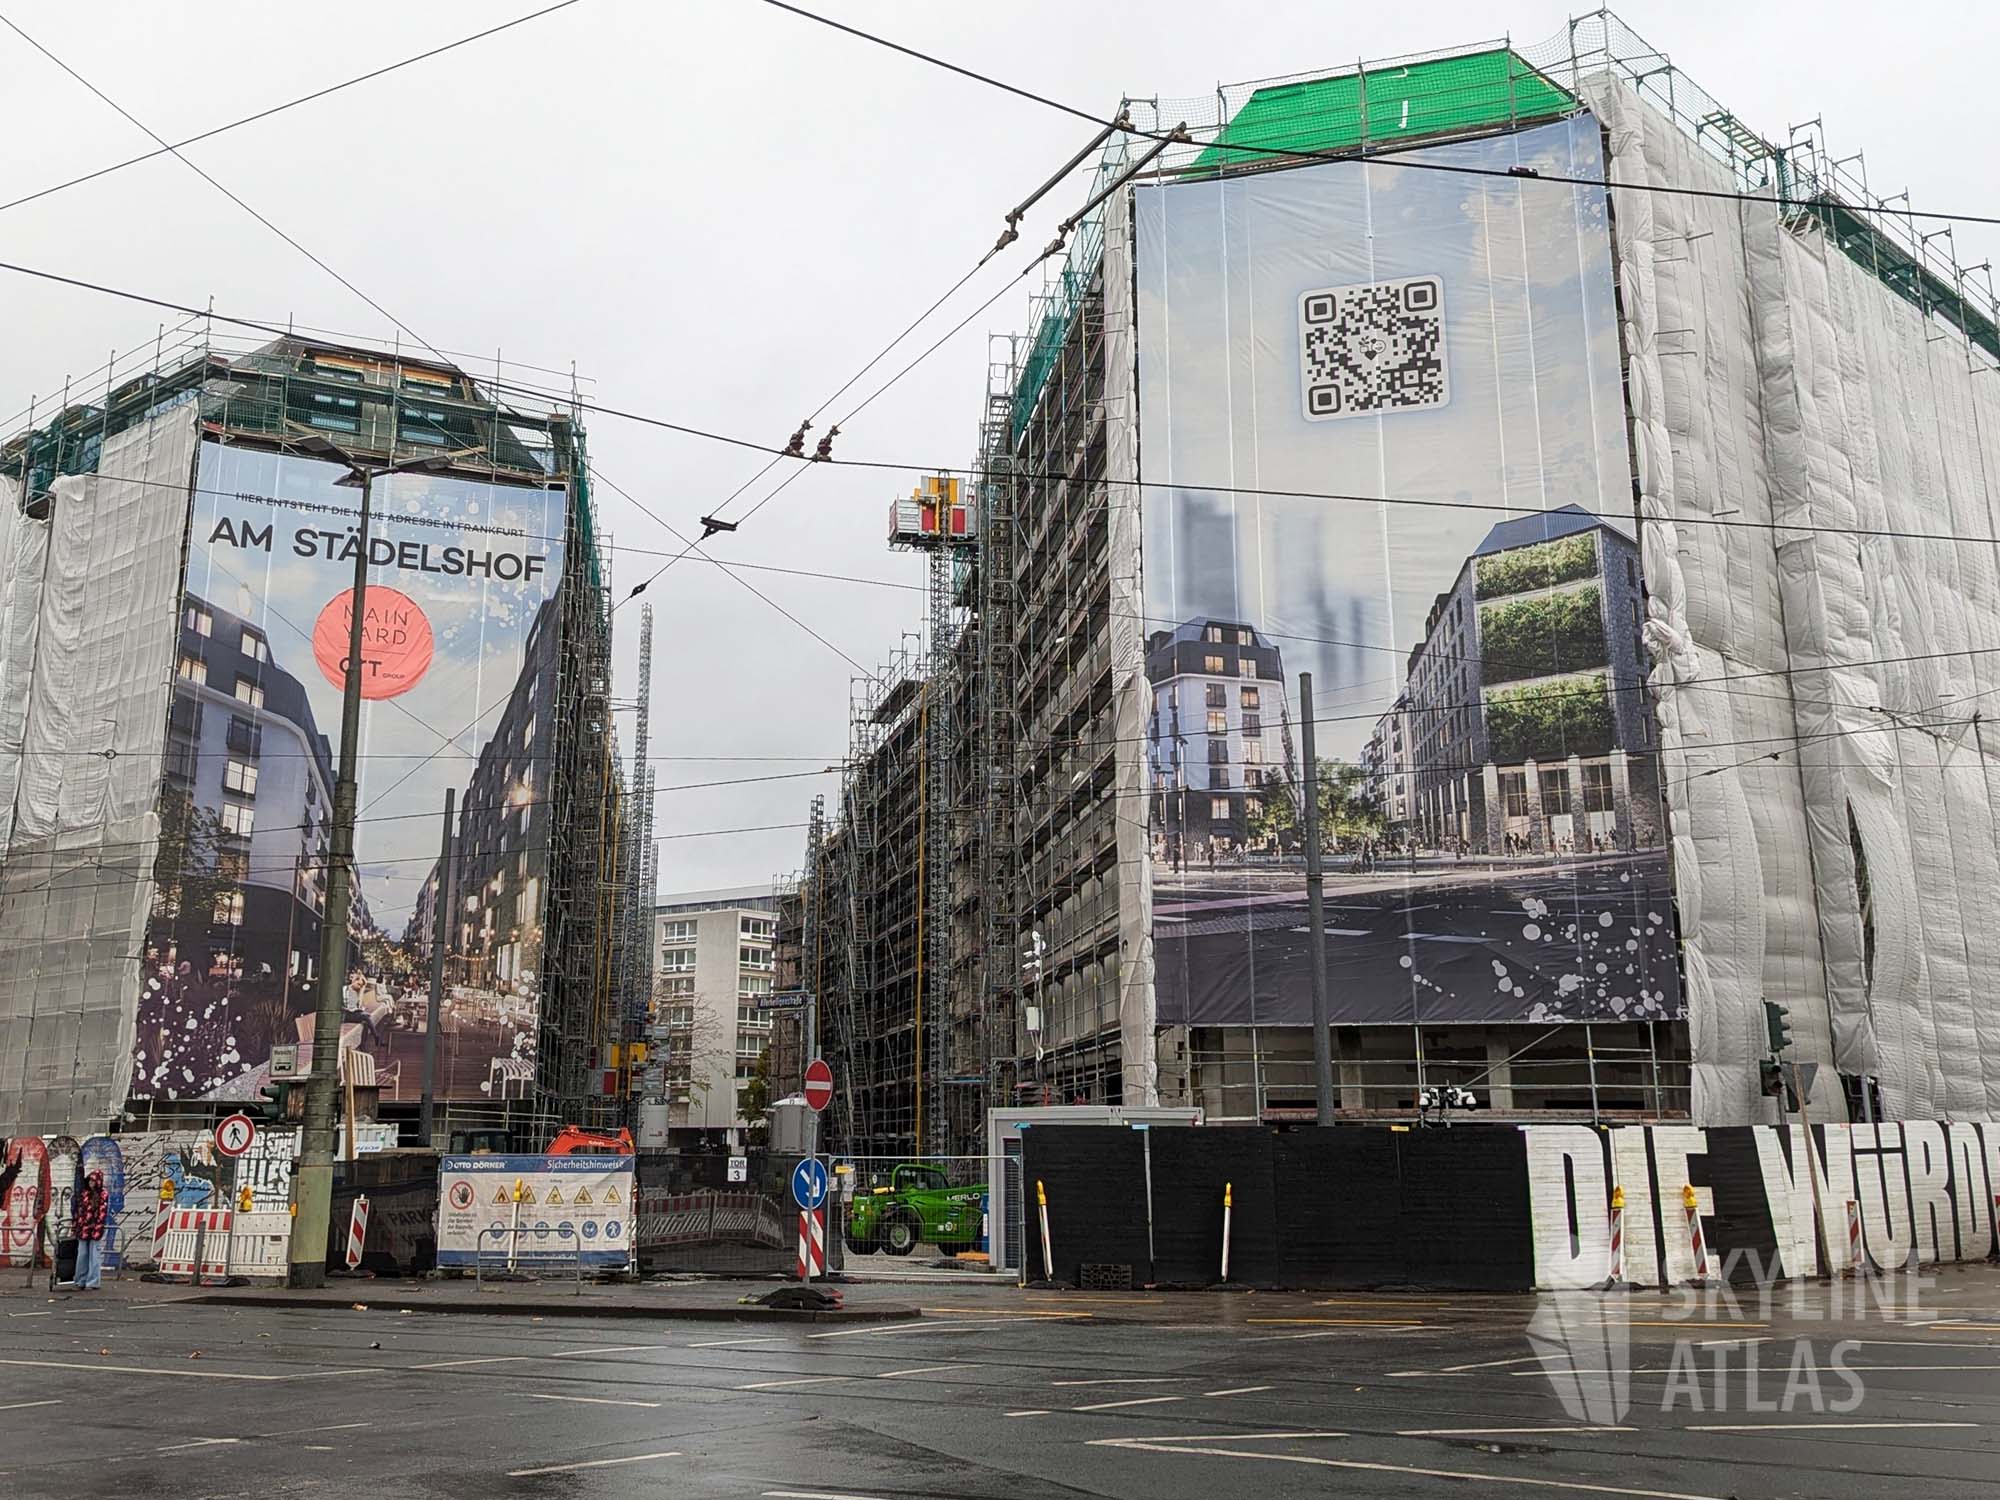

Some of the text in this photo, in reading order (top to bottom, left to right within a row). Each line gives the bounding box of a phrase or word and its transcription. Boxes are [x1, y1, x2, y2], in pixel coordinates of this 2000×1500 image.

[235, 492, 525, 538] HIER ENTSTEHT DIE NUE ADRESSE IN FRANKFURT
[207, 516, 546, 582] AM STÄDELSHOF
[453, 1159, 505, 1169] OTTO DÖRNER
[730, 1159, 745, 1168] TOR
[733, 1170, 740, 1180] 3
[236, 1158, 292, 1195] ALLES
[946, 1192, 981, 1202] MERLO
[1525, 1124, 1720, 1290] DIE
